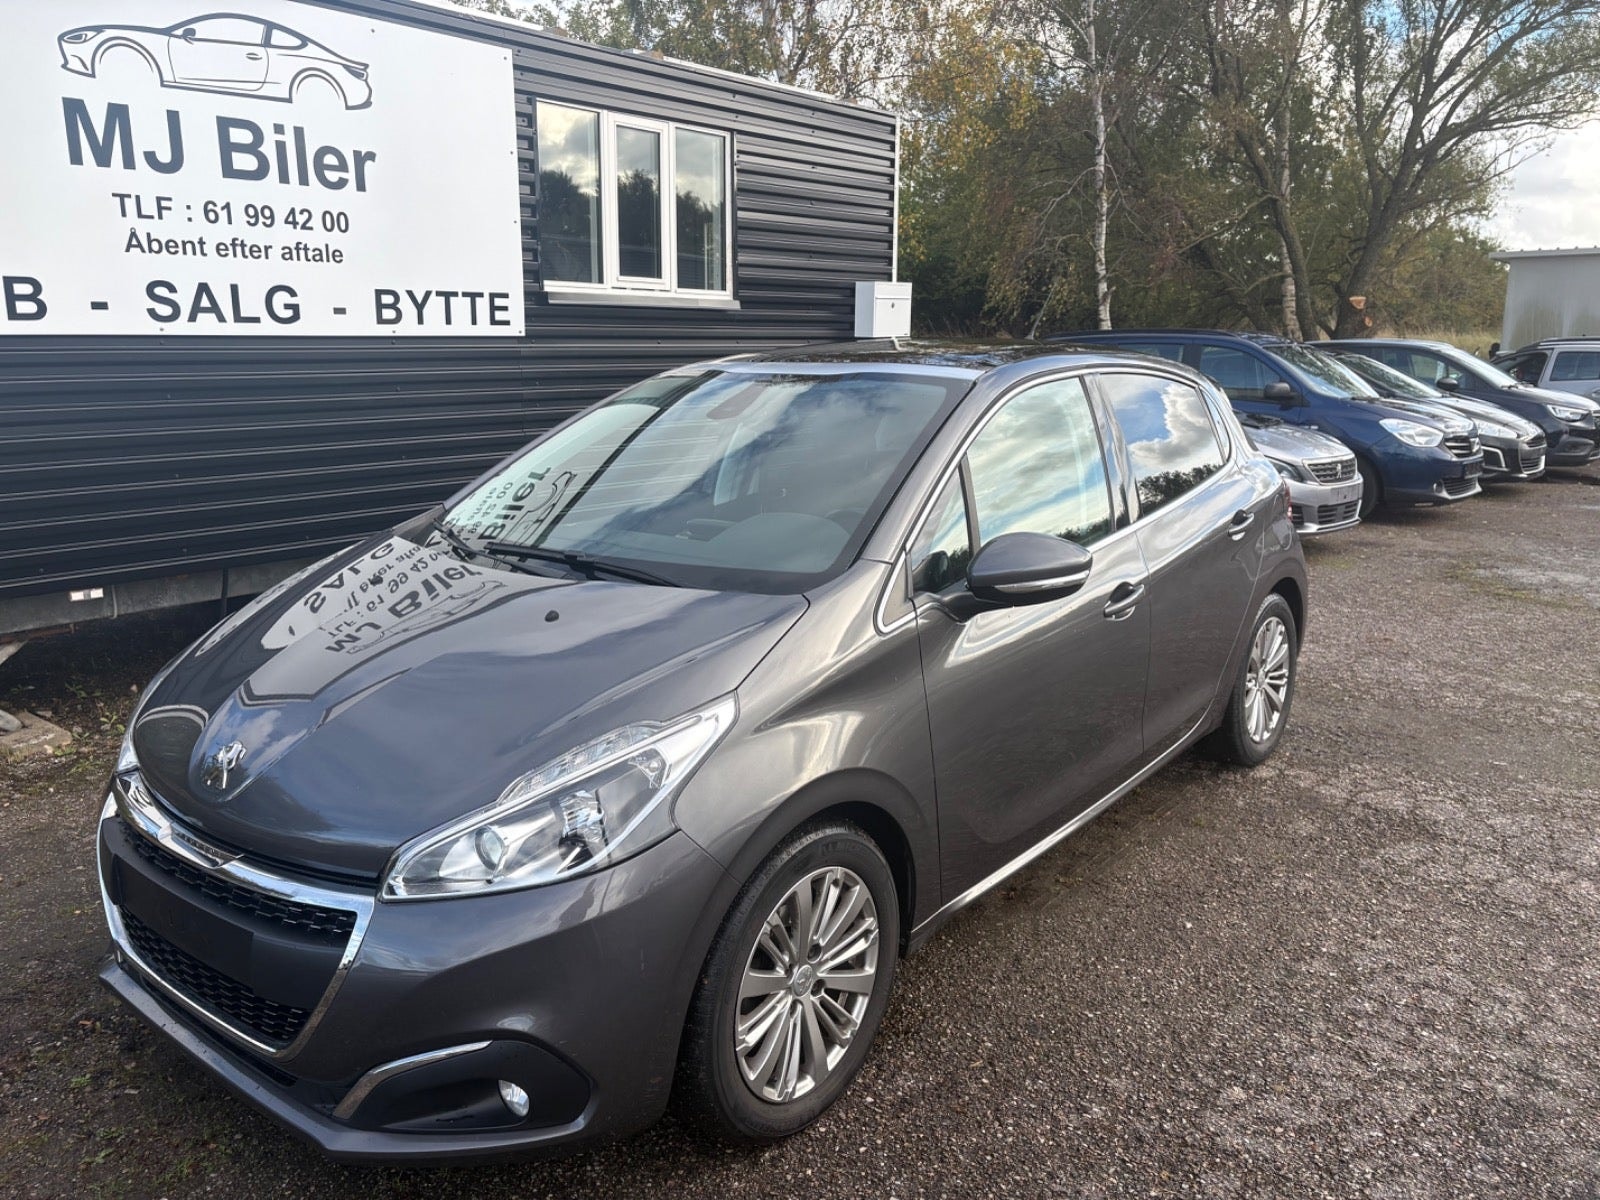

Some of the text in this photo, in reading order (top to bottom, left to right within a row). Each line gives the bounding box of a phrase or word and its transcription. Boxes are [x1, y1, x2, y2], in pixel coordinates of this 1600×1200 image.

[62, 97, 376, 192] MJ Biler
[112, 193, 173, 221] TLF
[203, 201, 233, 225] 61
[244, 203, 275, 228] 99
[284, 207, 314, 231] 42
[321, 210, 349, 234] 00
[125, 228, 344, 264] Åbent efter aftale
[3, 276, 47, 321] B
[146, 280, 301, 325] SALG
[375, 289, 511, 326] BYTTE
